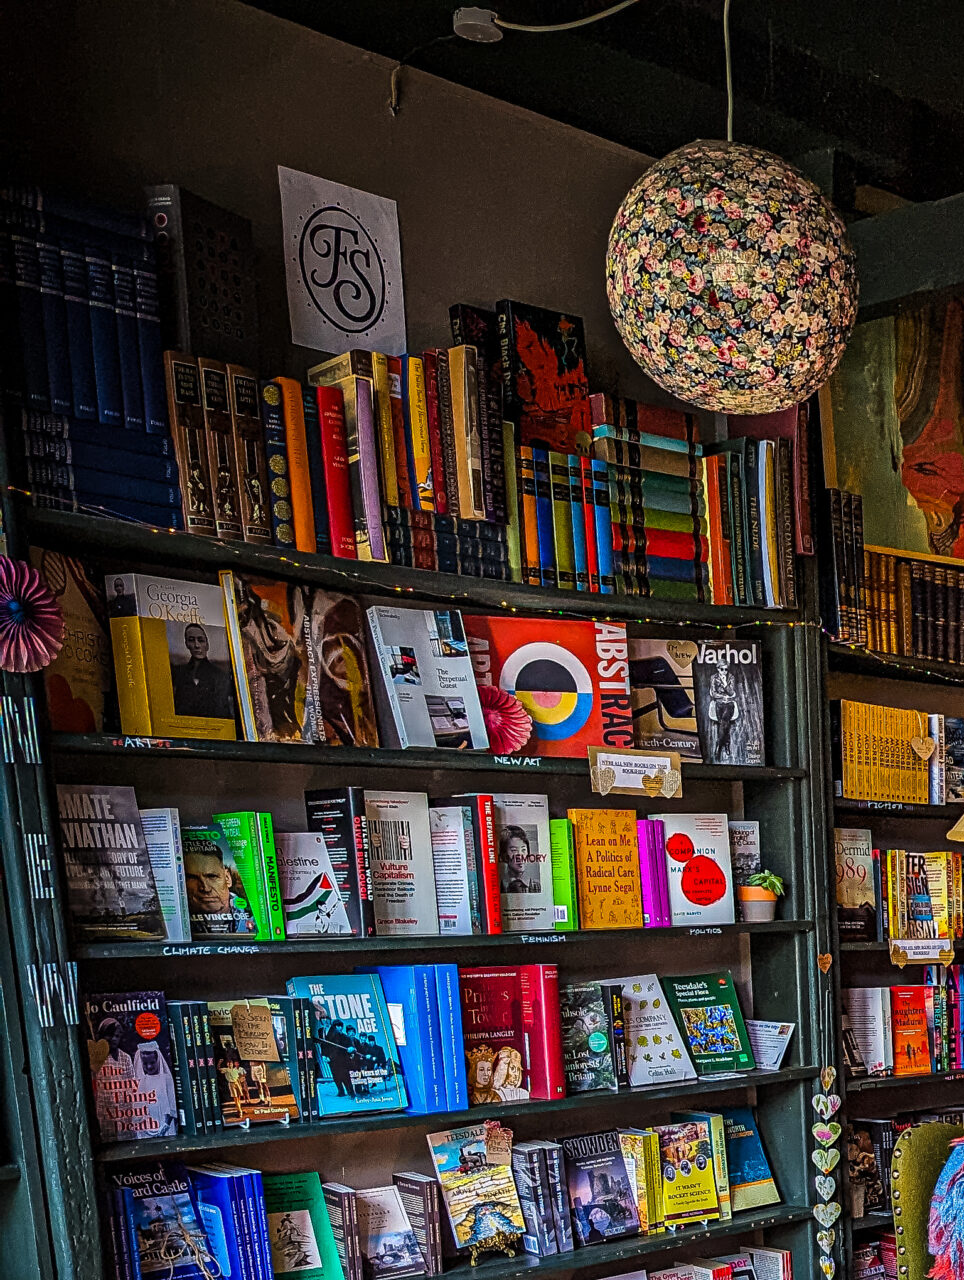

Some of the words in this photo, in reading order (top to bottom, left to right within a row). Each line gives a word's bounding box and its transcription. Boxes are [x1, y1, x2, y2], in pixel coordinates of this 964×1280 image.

[782, 472, 792, 530] LEONARDO
[751, 520, 760, 550] NUDE
[146, 584, 199, 611] Georgia
[148, 602, 206, 625] O'Keeffe
[302, 614, 315, 666] ABSTRACT
[438, 675, 468, 684] Perpetual
[595, 622, 634, 747] ABSTRAC
[124, 737, 152, 748] ART
[494, 756, 521, 766] NEW
[523, 757, 542, 767] ART
[354, 816, 363, 850] OLIVER
[486, 817, 494, 847] DEFAULT
[586, 834, 606, 846] Lean
[608, 837, 617, 846] on
[620, 834, 632, 846] Me
[277, 857, 319, 866] alestine
[361, 815, 369, 850] BUTLER
[366, 869, 374, 901] WORLD
[488, 848, 496, 864] LINE
[508, 854, 547, 863] MEMORY
[586, 852, 594, 863] A
[596, 850, 621, 863] Politics
[623, 850, 632, 863] of
[380, 863, 408, 871] Vulture
[586, 866, 616, 878] Radical
[617, 867, 635, 878] Care
[357, 852, 367, 900] BULLOUGH
[373, 871, 414, 880] Capitalism
[266, 855, 280, 912] MANIFESTO
[588, 881, 612, 895] Lynne
[614, 881, 635, 893] Segal
[206, 912, 232, 921] VINCE
[233, 912, 249, 921] OBE
[689, 927, 722, 935] POLITICS
[521, 935, 566, 943] FEMINISM
[163, 946, 211, 956] CLIMATE
[217, 946, 259, 954] CHANGE
[309, 984, 325, 995] THE
[673, 982, 708, 990] Teesdale's
[102, 999, 160, 1013] Caulfield
[311, 994, 375, 1020] STONE
[636, 1014, 667, 1023] COMPANY
[356, 1018, 379, 1033] AGE
[572, 1050, 589, 1058] Lost
[102, 1066, 124, 1077] The
[569, 1072, 595, 1082] Britain
[114, 1090, 156, 1103] Thing
[105, 1106, 149, 1119] About
[114, 1118, 159, 1132] Death
[445, 1128, 485, 1143] TEESDALE
[113, 1172, 153, 1187] Voices
[154, 1170, 165, 1184] of
[153, 1180, 189, 1196] Castle
[668, 1192, 689, 1200] ROCKET
